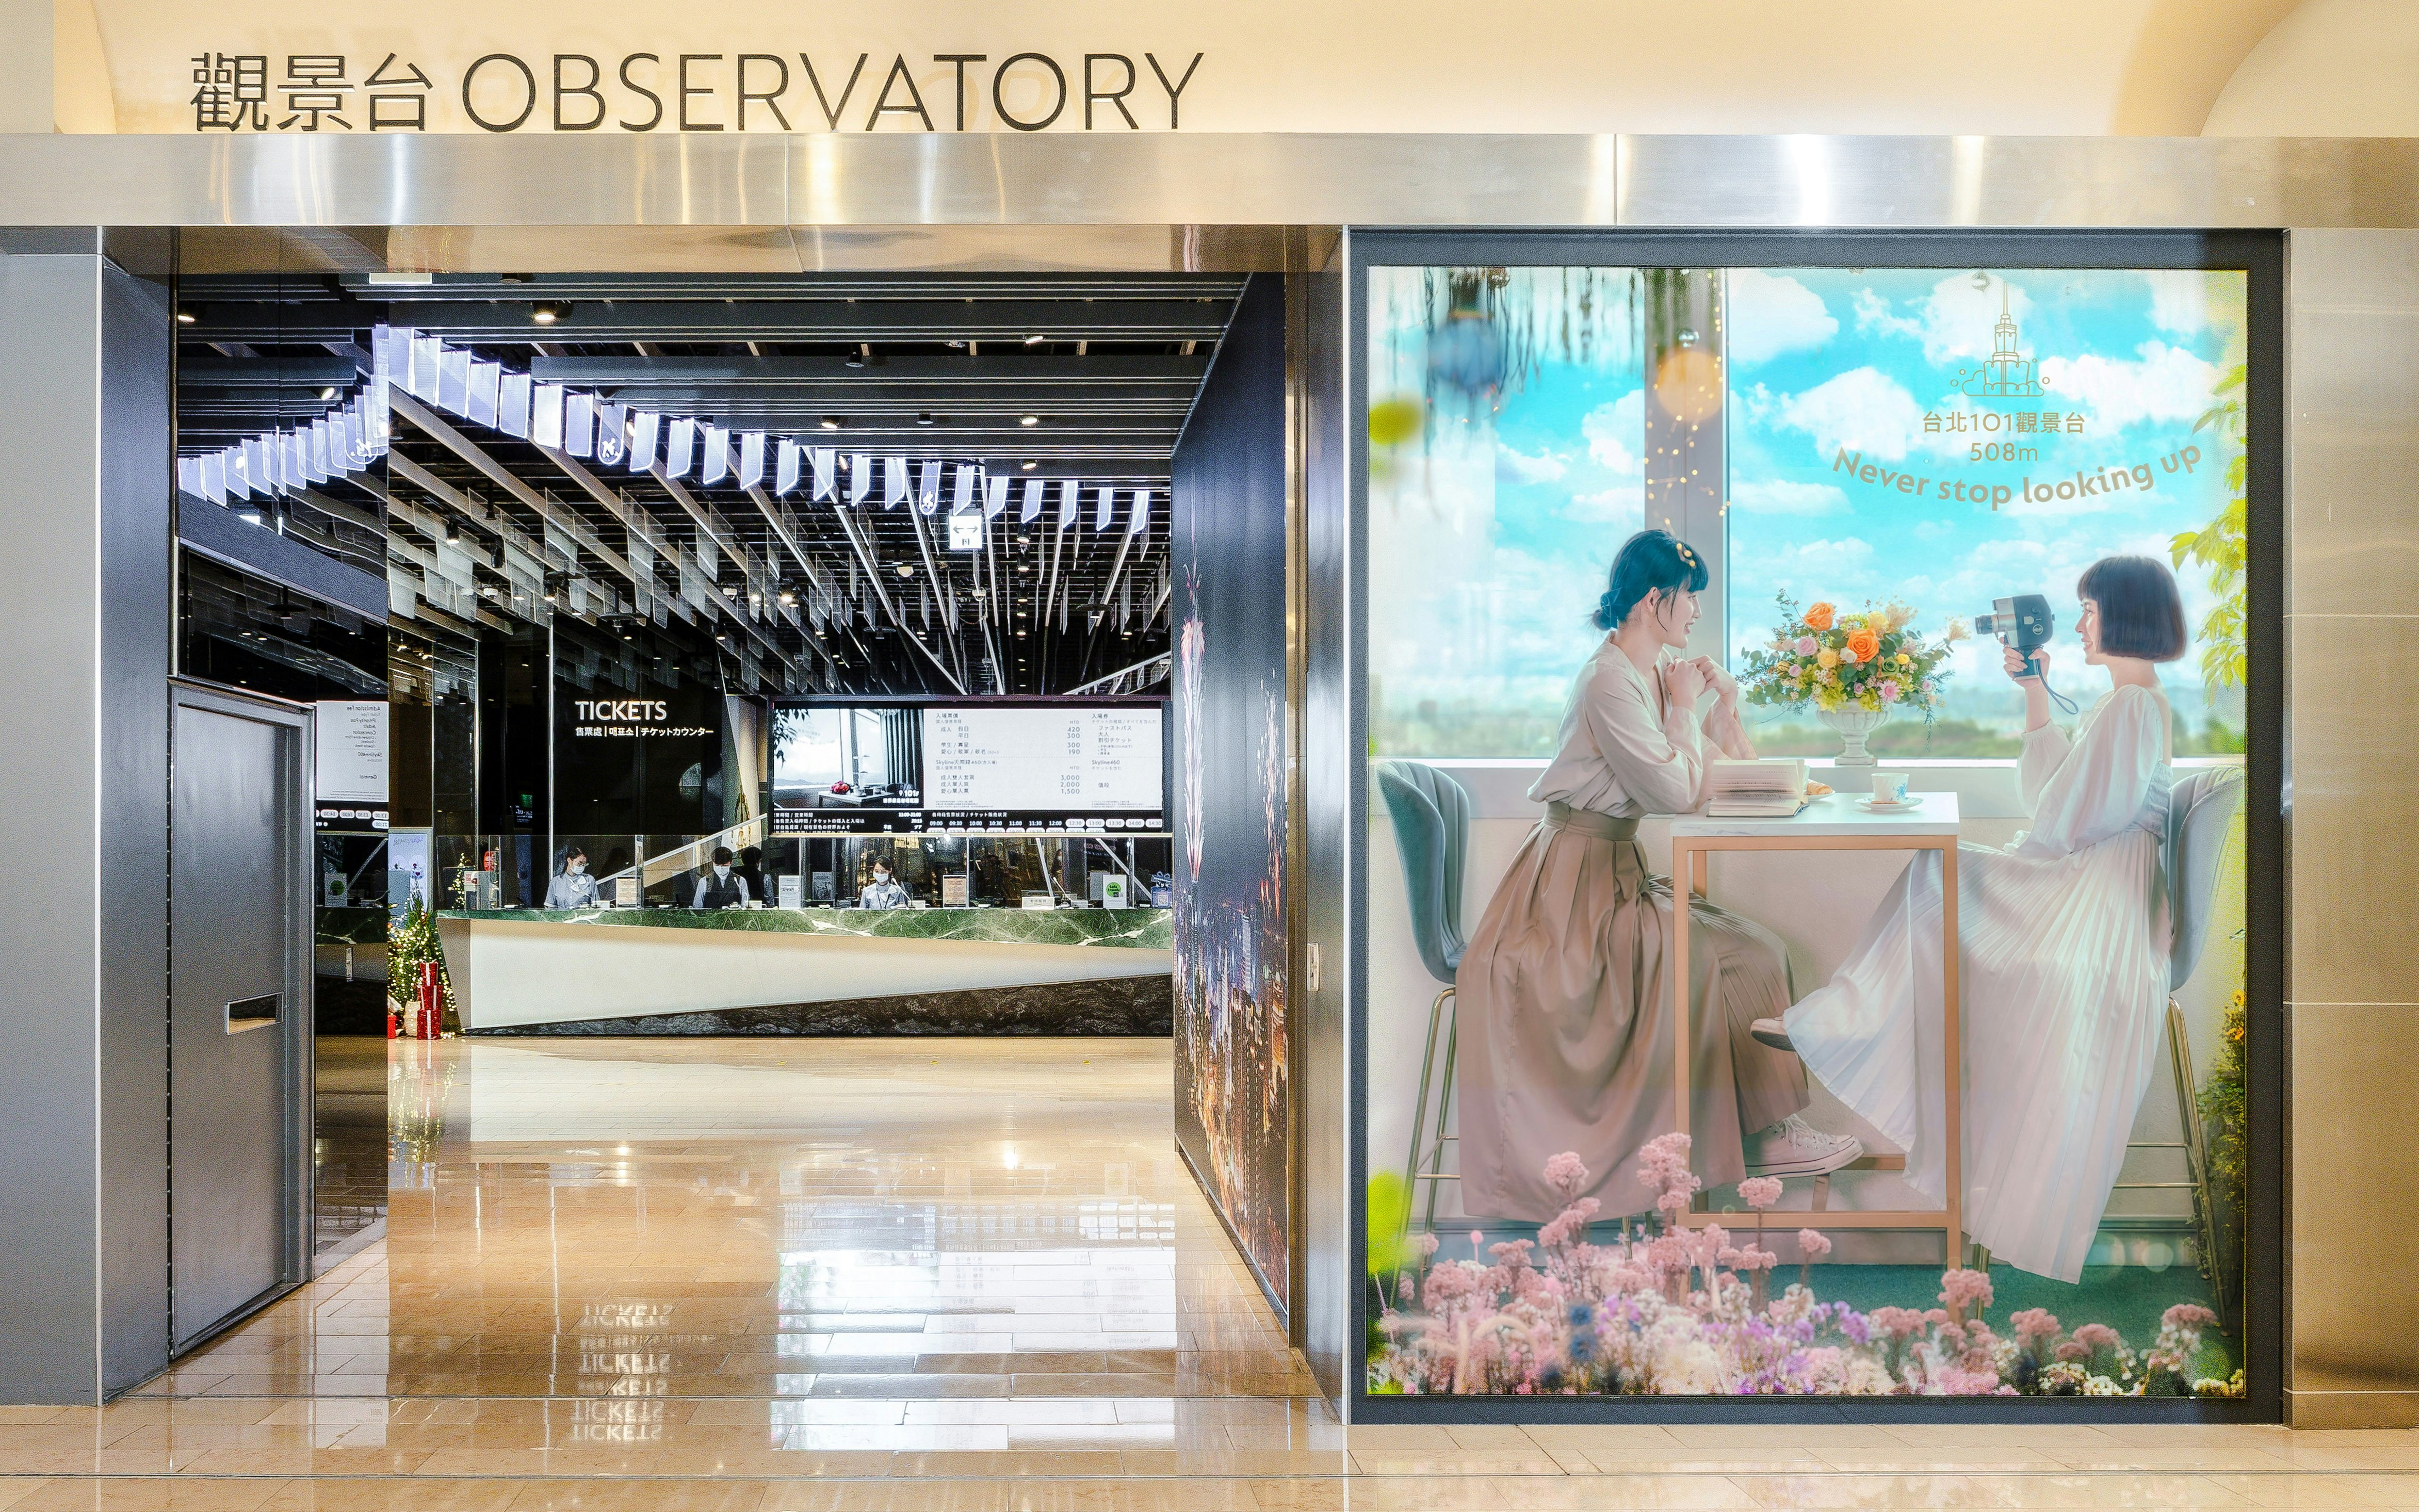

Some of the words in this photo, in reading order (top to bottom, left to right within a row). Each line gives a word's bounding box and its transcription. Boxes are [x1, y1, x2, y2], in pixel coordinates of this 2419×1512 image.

[190, 52, 432, 131] 觀景台
[462, 53, 1204, 131] OBSERVATORY
[1923, 412, 2085, 434] 台北101觀景台
[1970, 443, 2038, 462] 508m
[1832, 447, 1929, 497] Never
[1938, 478, 2012, 511] stop
[2023, 463, 2154, 505] looking
[2160, 445, 2202, 476] up
[575, 701, 667, 720] TICKETS
[641, 727, 714, 737] チケットカウンター
